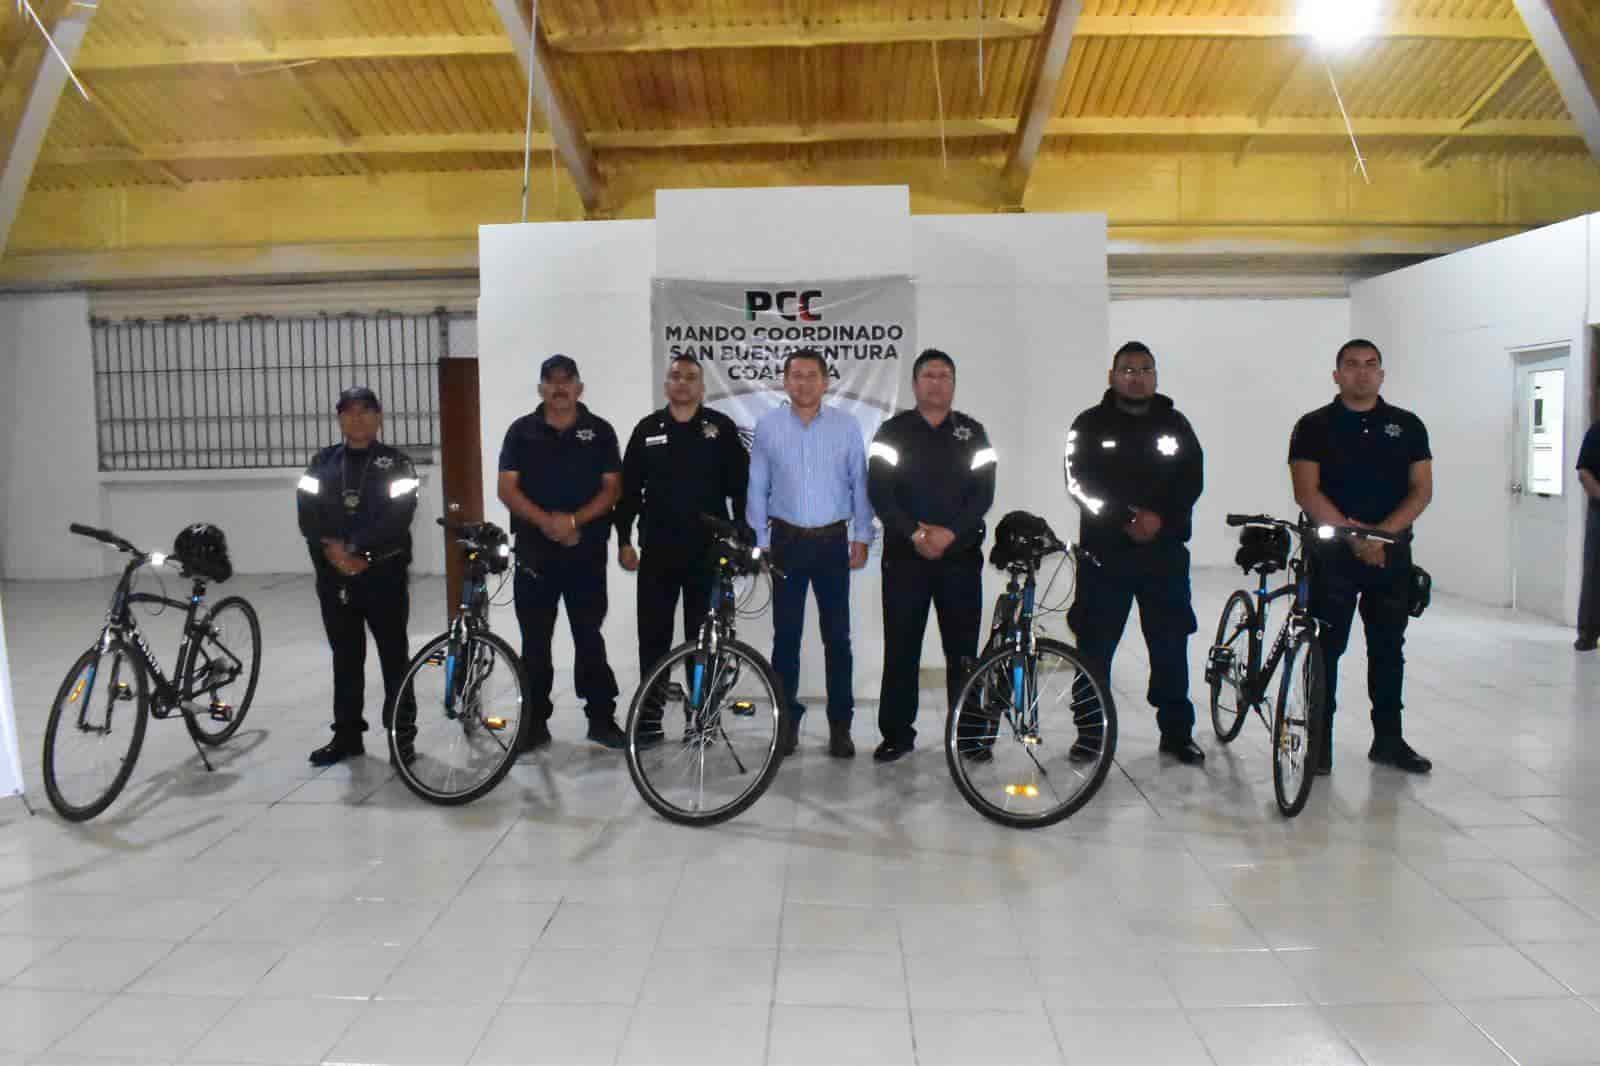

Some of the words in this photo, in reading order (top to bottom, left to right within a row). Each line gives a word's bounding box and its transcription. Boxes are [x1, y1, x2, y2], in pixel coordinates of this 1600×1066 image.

[745, 290, 822, 321] PCC
[665, 325, 746, 341] MANDO
[753, 325, 903, 341] COORDINADO
[670, 344, 714, 360] SAN
[728, 365, 841, 380] COAHA
